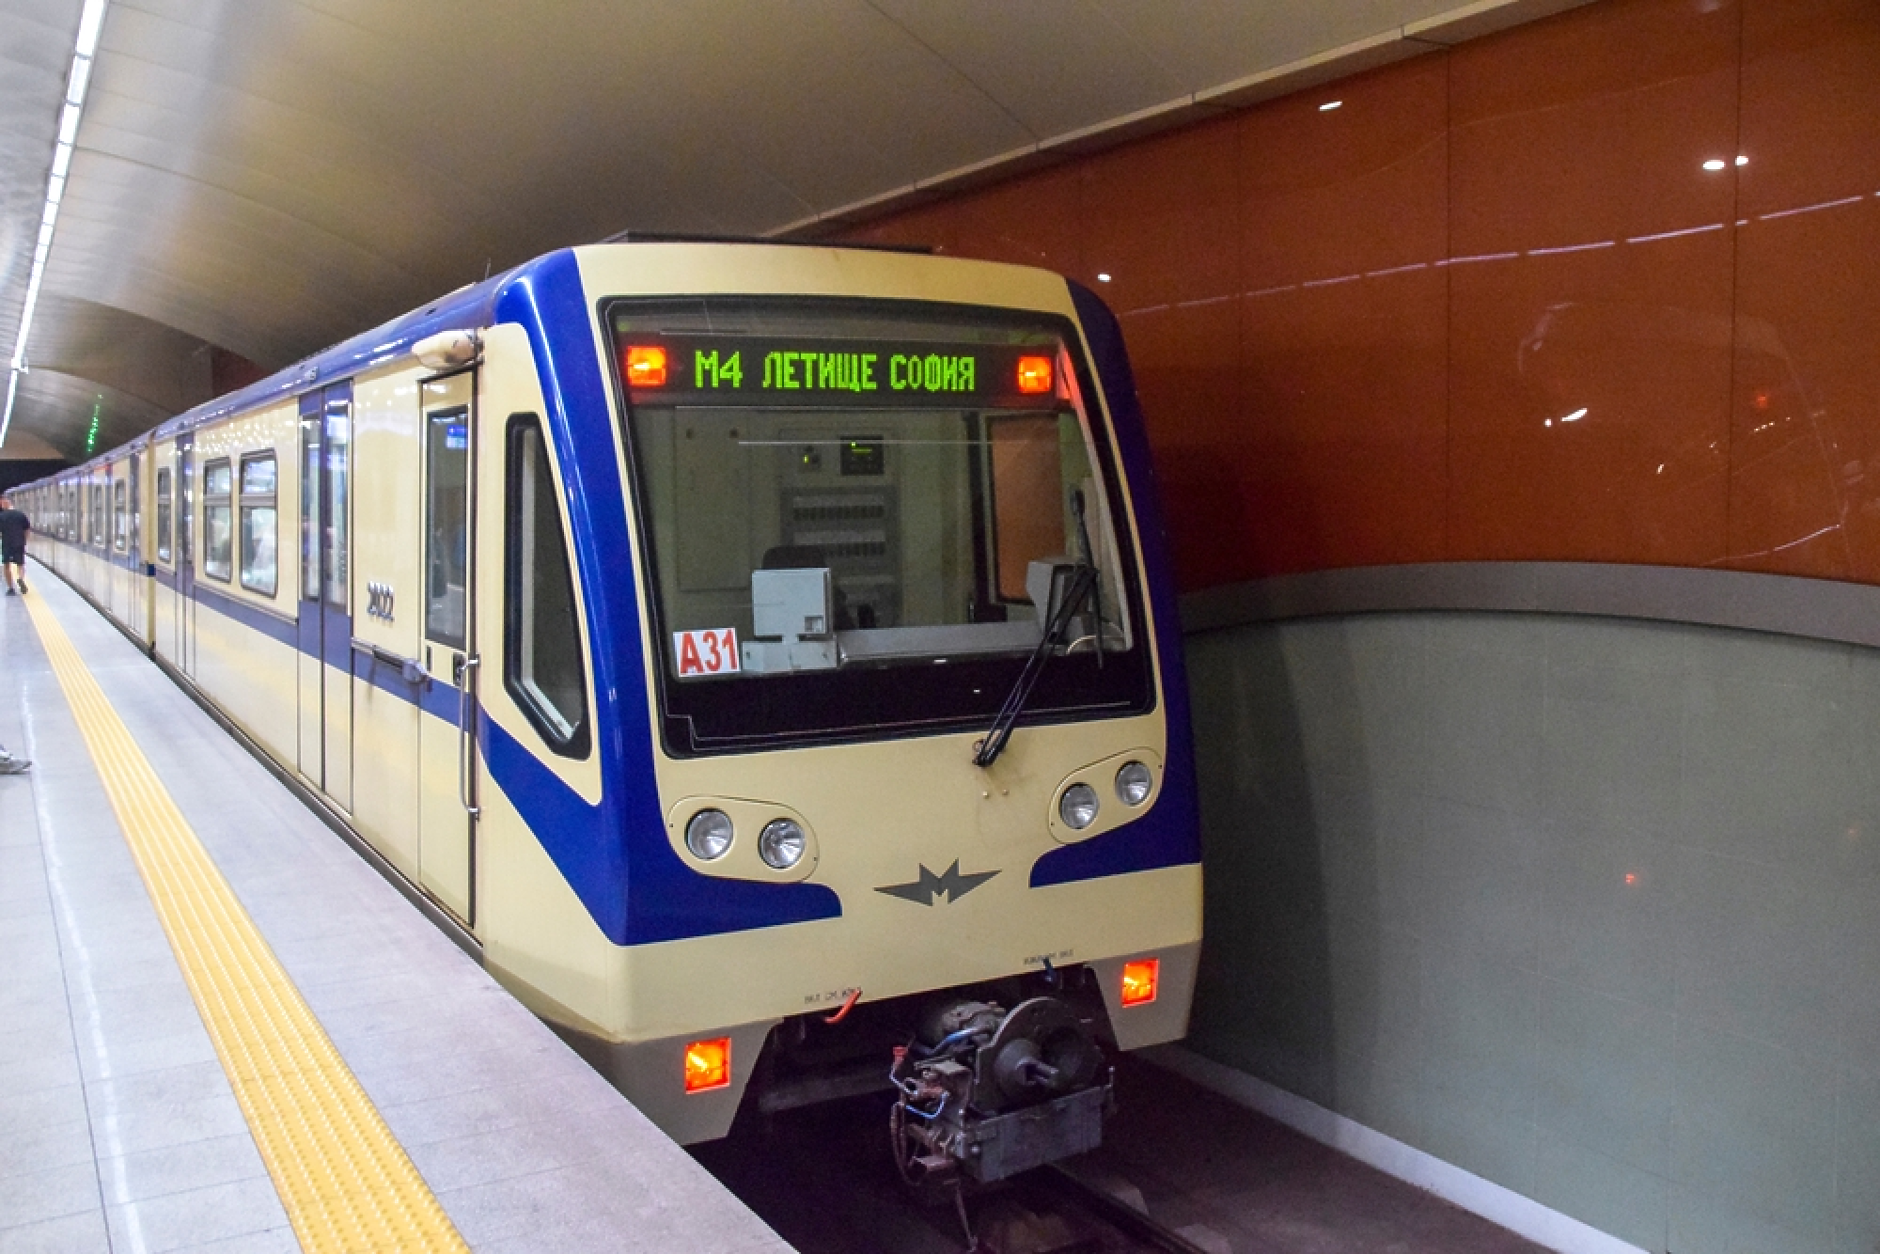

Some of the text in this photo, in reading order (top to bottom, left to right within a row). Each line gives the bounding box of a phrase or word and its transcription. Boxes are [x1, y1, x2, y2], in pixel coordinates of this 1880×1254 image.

[695, 350, 975, 392] М4 ЛЕТИЩЕ СОФИЯ
[680, 629, 738, 674] А31
